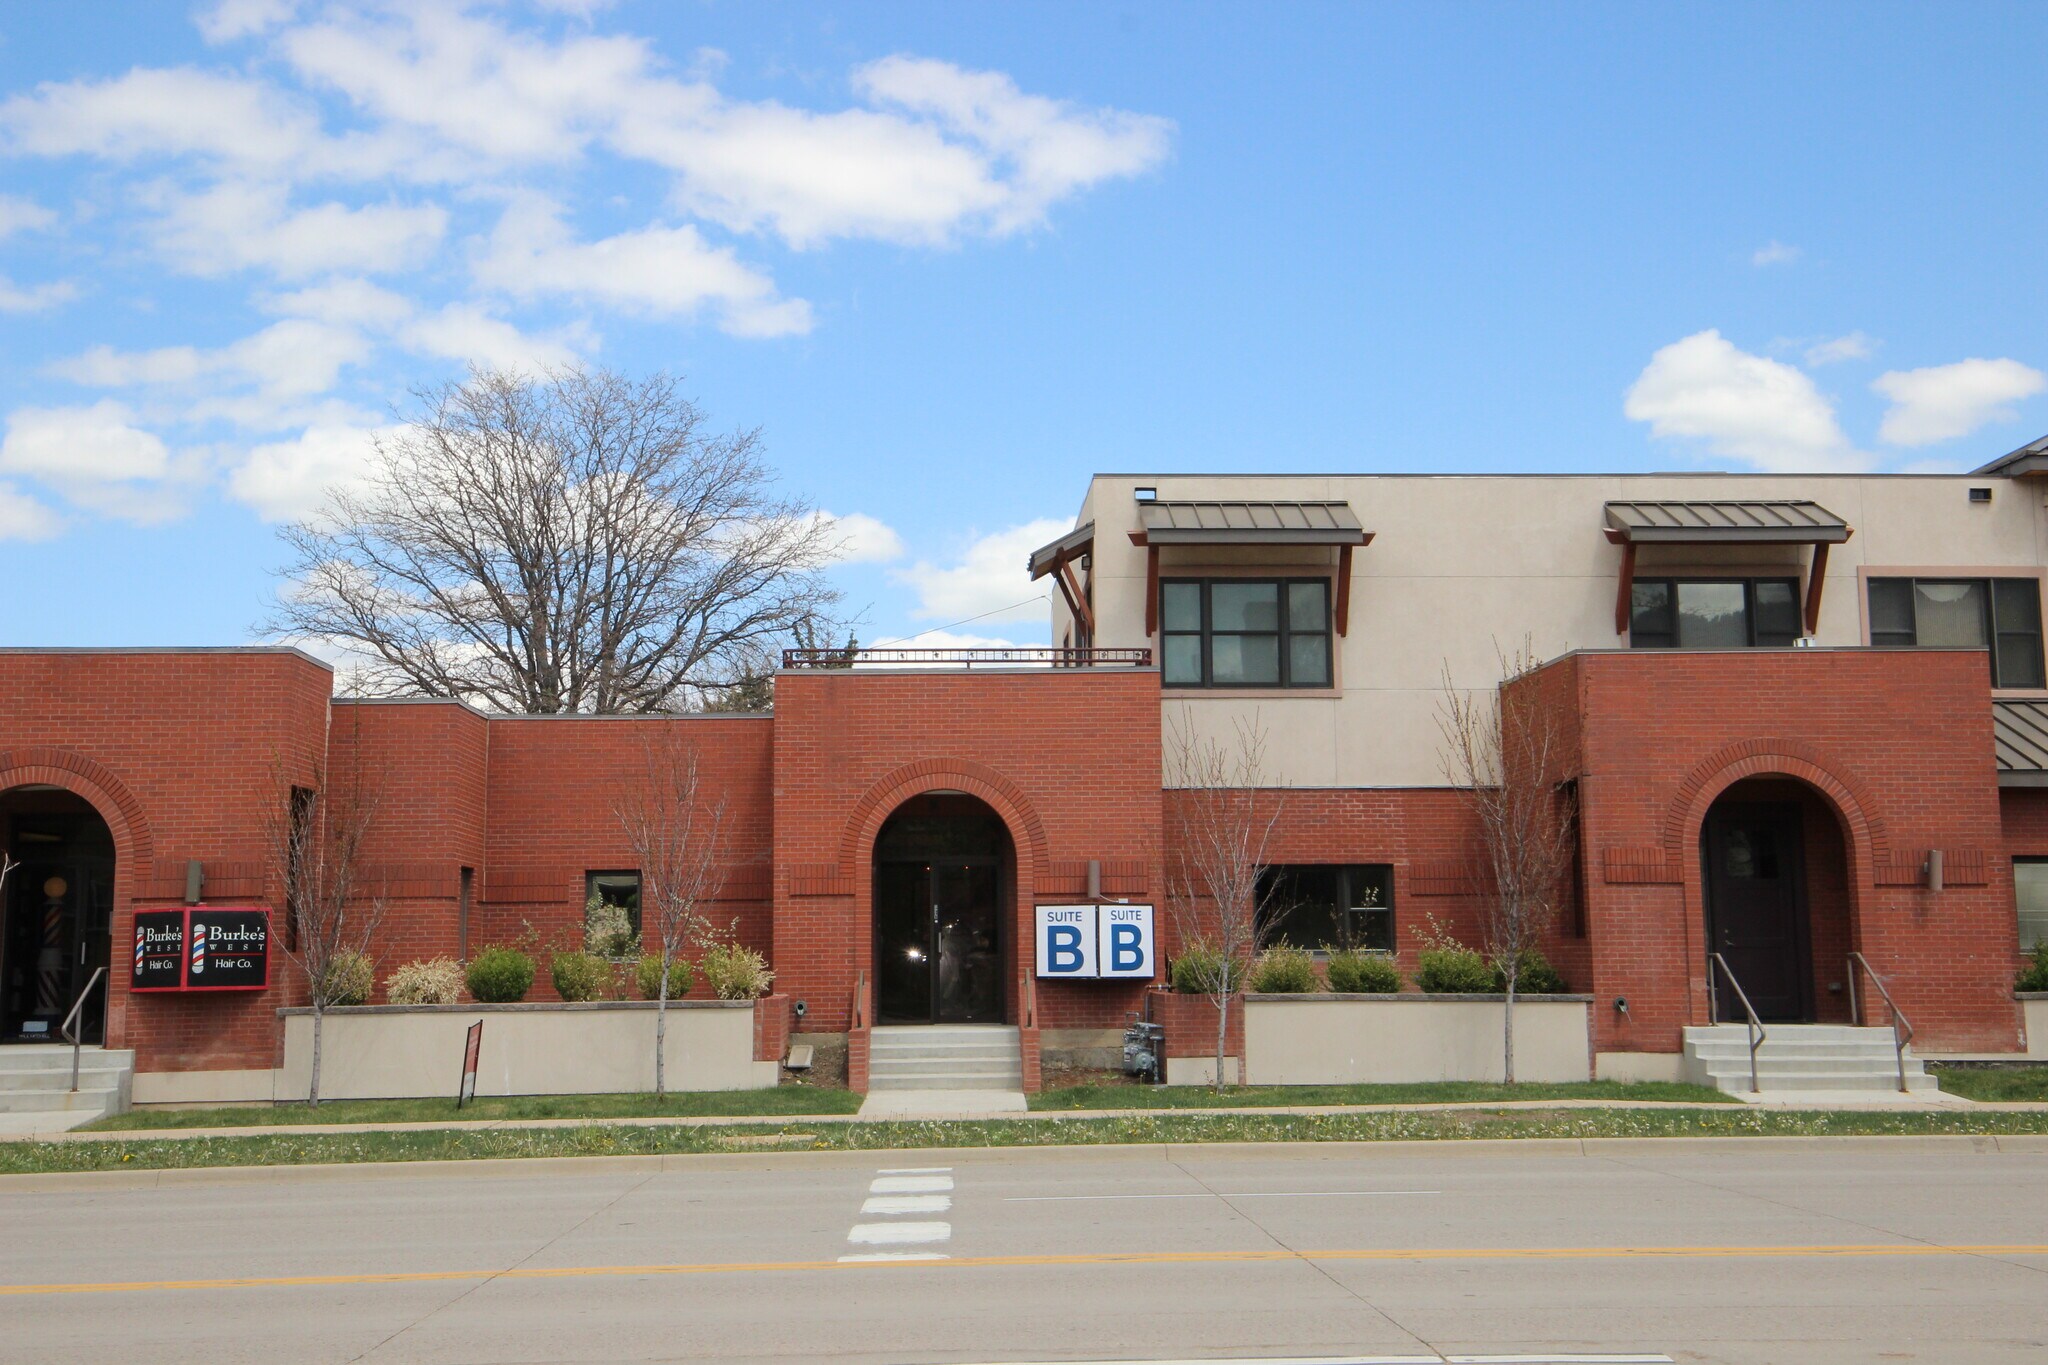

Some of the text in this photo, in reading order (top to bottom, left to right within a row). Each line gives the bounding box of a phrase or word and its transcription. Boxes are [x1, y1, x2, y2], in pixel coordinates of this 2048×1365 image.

[1047, 911, 1082, 922] SUITE
[1110, 910, 1142, 921] SUITE
[146, 924, 183, 942] Burke's
[209, 924, 265, 941] Burke's
[209, 943, 264, 951] WEST
[1047, 925, 1084, 972] B
[1111, 924, 1144, 971] B
[149, 959, 173, 970] Hair Co.
[215, 959, 253, 969] Hair Co.
